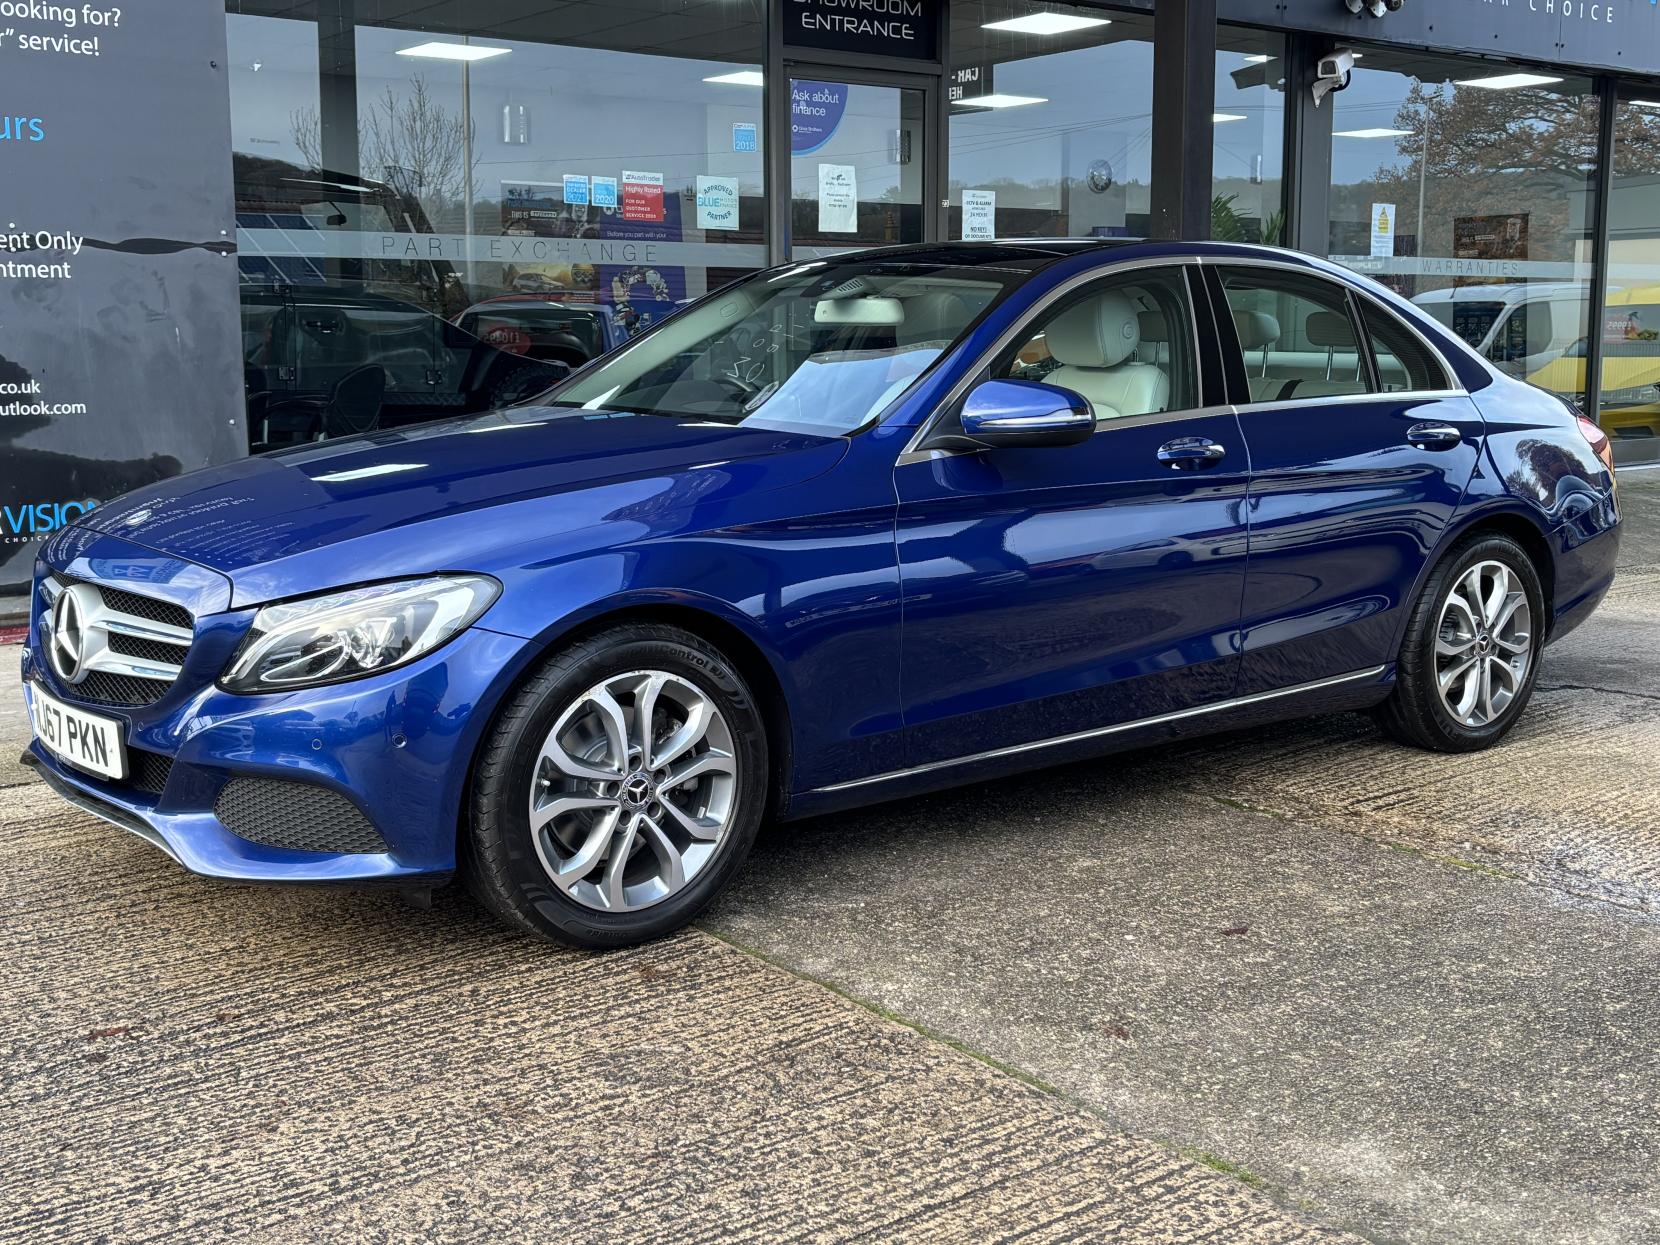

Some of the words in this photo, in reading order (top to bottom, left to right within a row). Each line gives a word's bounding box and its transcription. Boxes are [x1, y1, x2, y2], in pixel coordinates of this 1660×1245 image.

[82, 4, 121, 27] for?
[802, 12, 915, 40] ENTRANCE
[18, 34, 100, 56] service!
[792, 89, 810, 101] Ask
[812, 91, 839, 104] about
[792, 103, 826, 116] finance
[625, 185, 642, 194] Highly
[643, 186, 661, 194] Rated
[704, 184, 734, 196] APPROVED
[595, 194, 615, 204] 2020
[697, 196, 720, 208] BLUE
[707, 210, 732, 221] PARTNER
[35, 230, 84, 256] Only
[382, 236, 465, 257] PART
[490, 239, 657, 262] EXCHANGE
[1422, 260, 1519, 276] WARRANTIES
[0, 379, 41, 394] co.uk
[0, 400, 87, 416] utlook.com
[3, 500, 97, 534] VISIO
[66, 714, 109, 768] PKN
